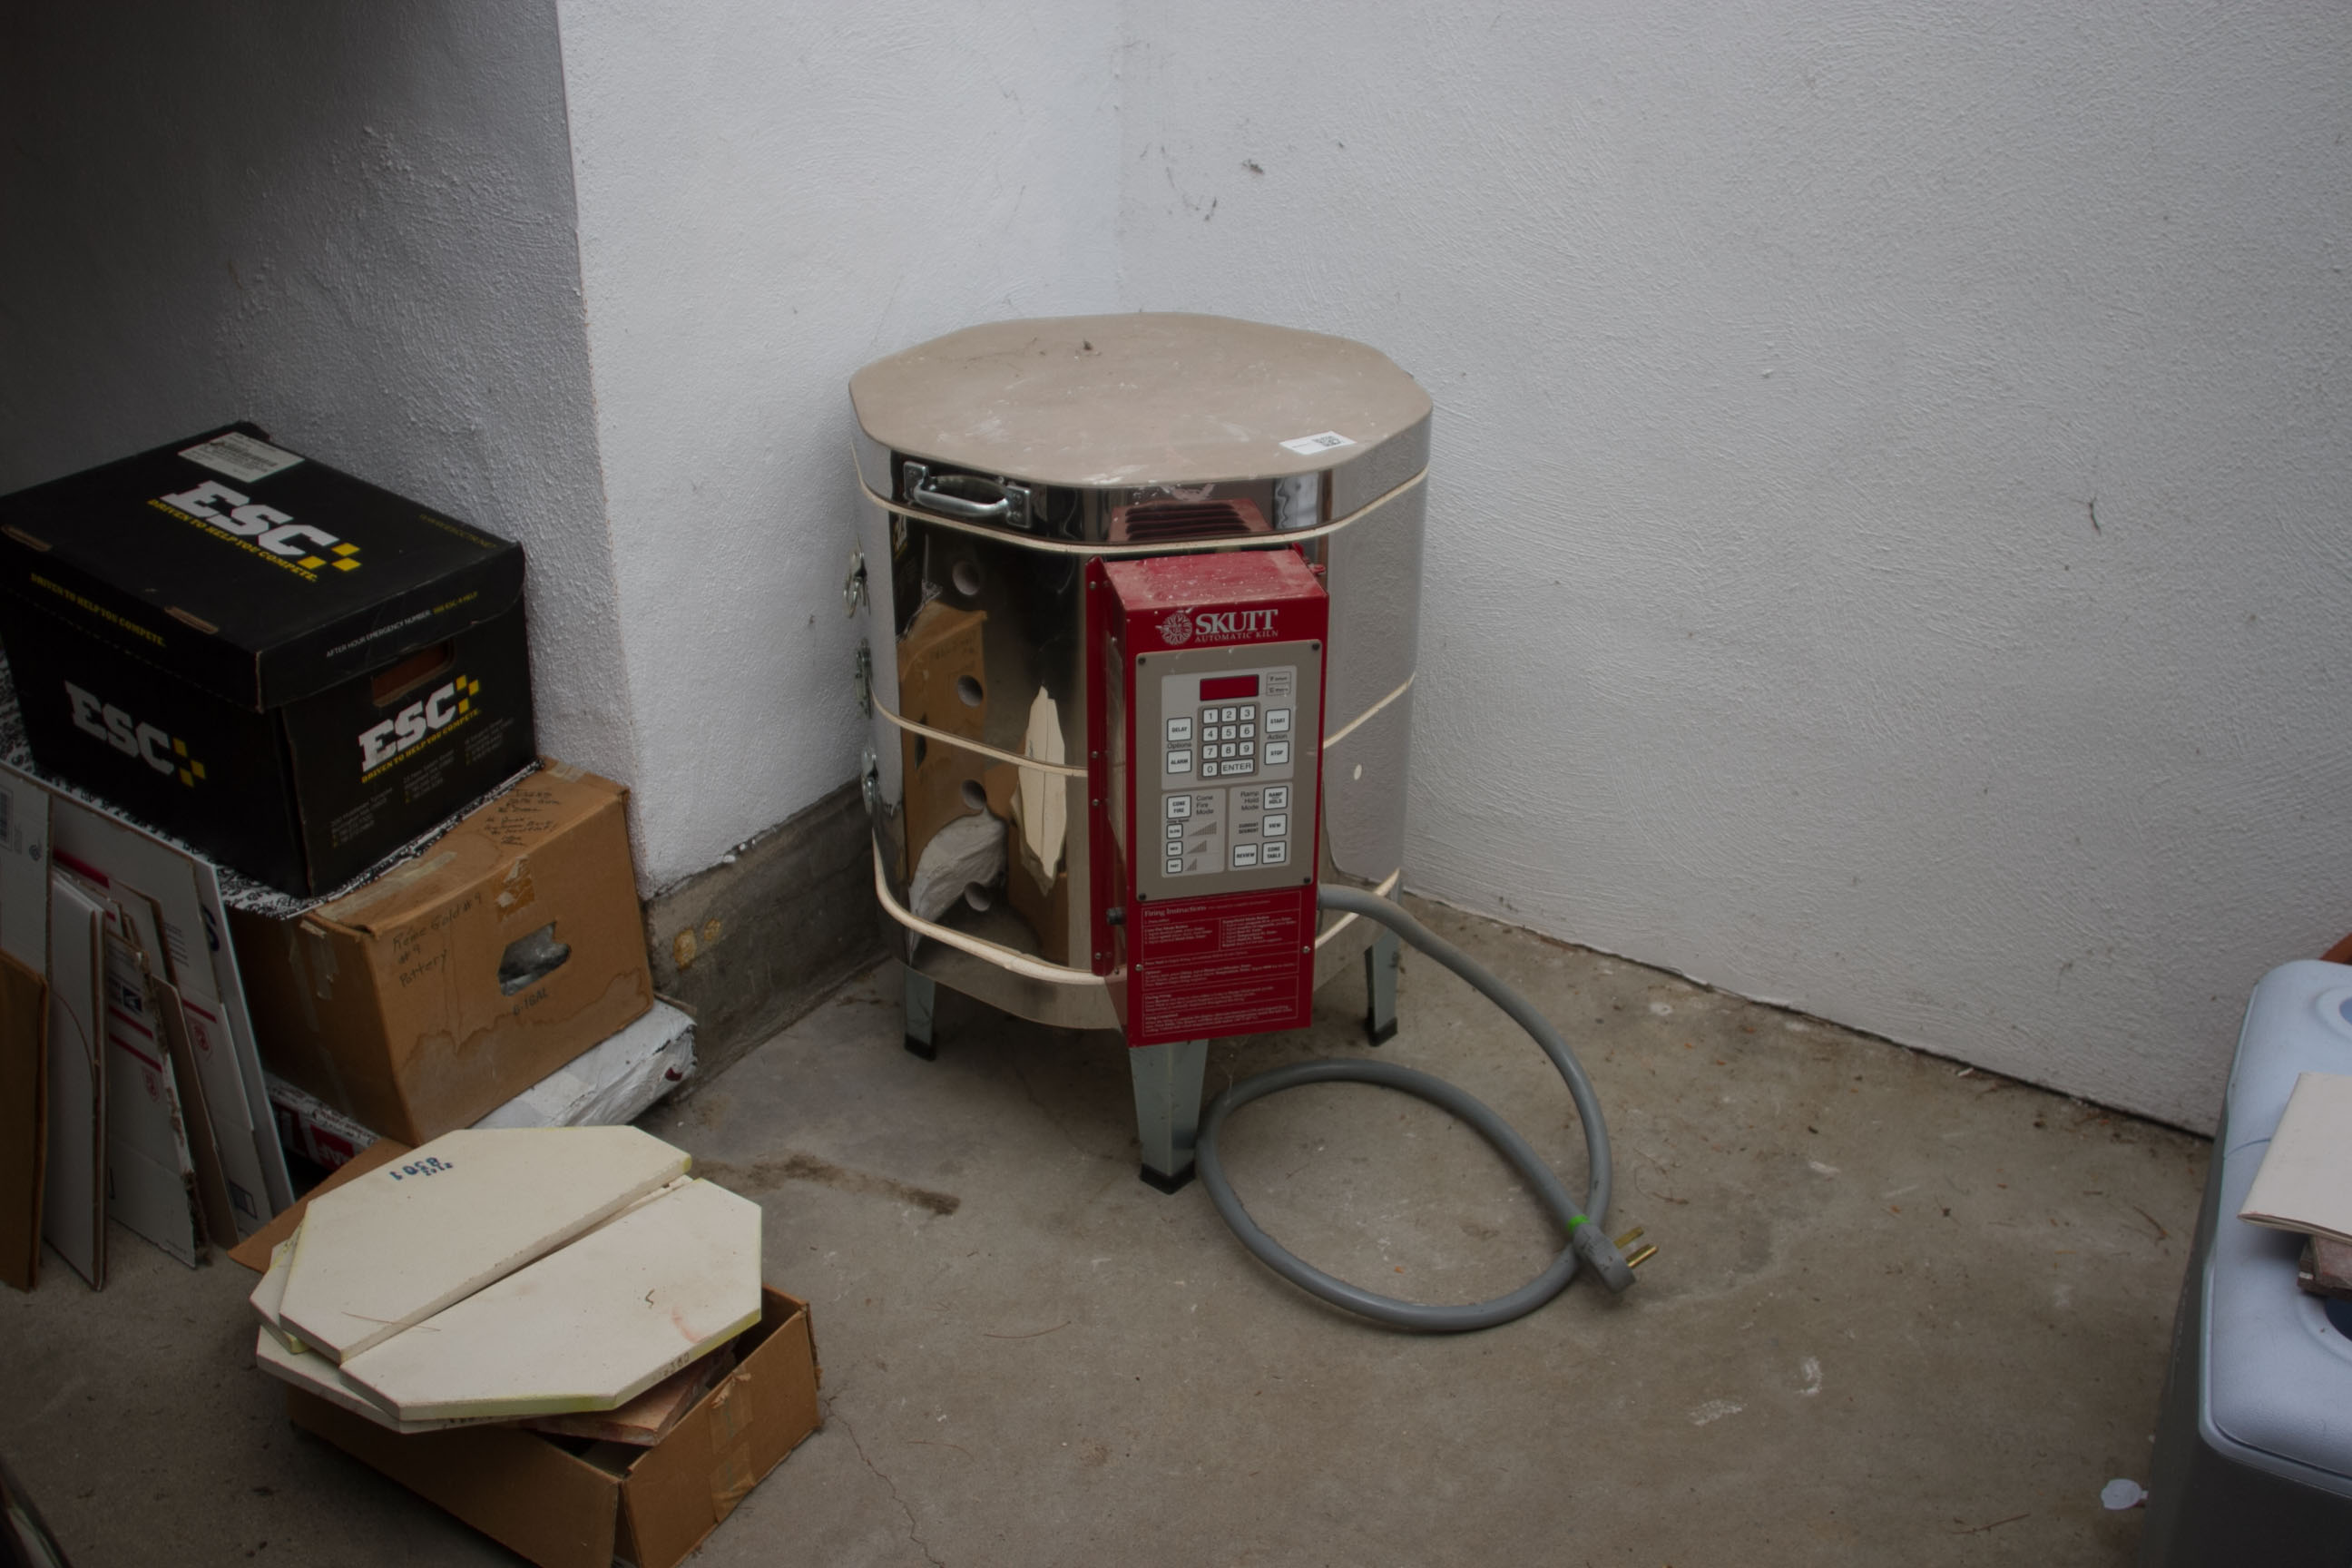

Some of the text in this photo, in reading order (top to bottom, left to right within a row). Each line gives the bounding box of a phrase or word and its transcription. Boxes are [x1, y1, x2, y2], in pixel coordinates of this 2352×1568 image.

[146, 498, 190, 522] DRIVEN
[205, 525, 238, 544] HELP
[159, 480, 340, 556] ESC
[76, 595, 100, 613] HELP
[101, 607, 118, 623] YOU
[1194, 608, 1279, 636] SKUTT
[326, 642, 348, 658] AFTER
[366, 621, 405, 641] EMERGENCY
[1194, 630, 1279, 644] AUTOMATIC KILN
[64, 680, 175, 777] ESC
[358, 681, 456, 773] ESC
[360, 760, 394, 784] DRIVEN
[405, 740, 428, 759] HELP
[426, 730, 443, 746] YOU
[1222, 762, 1252, 772] ENTER
[399, 948, 448, 987] Pottery
